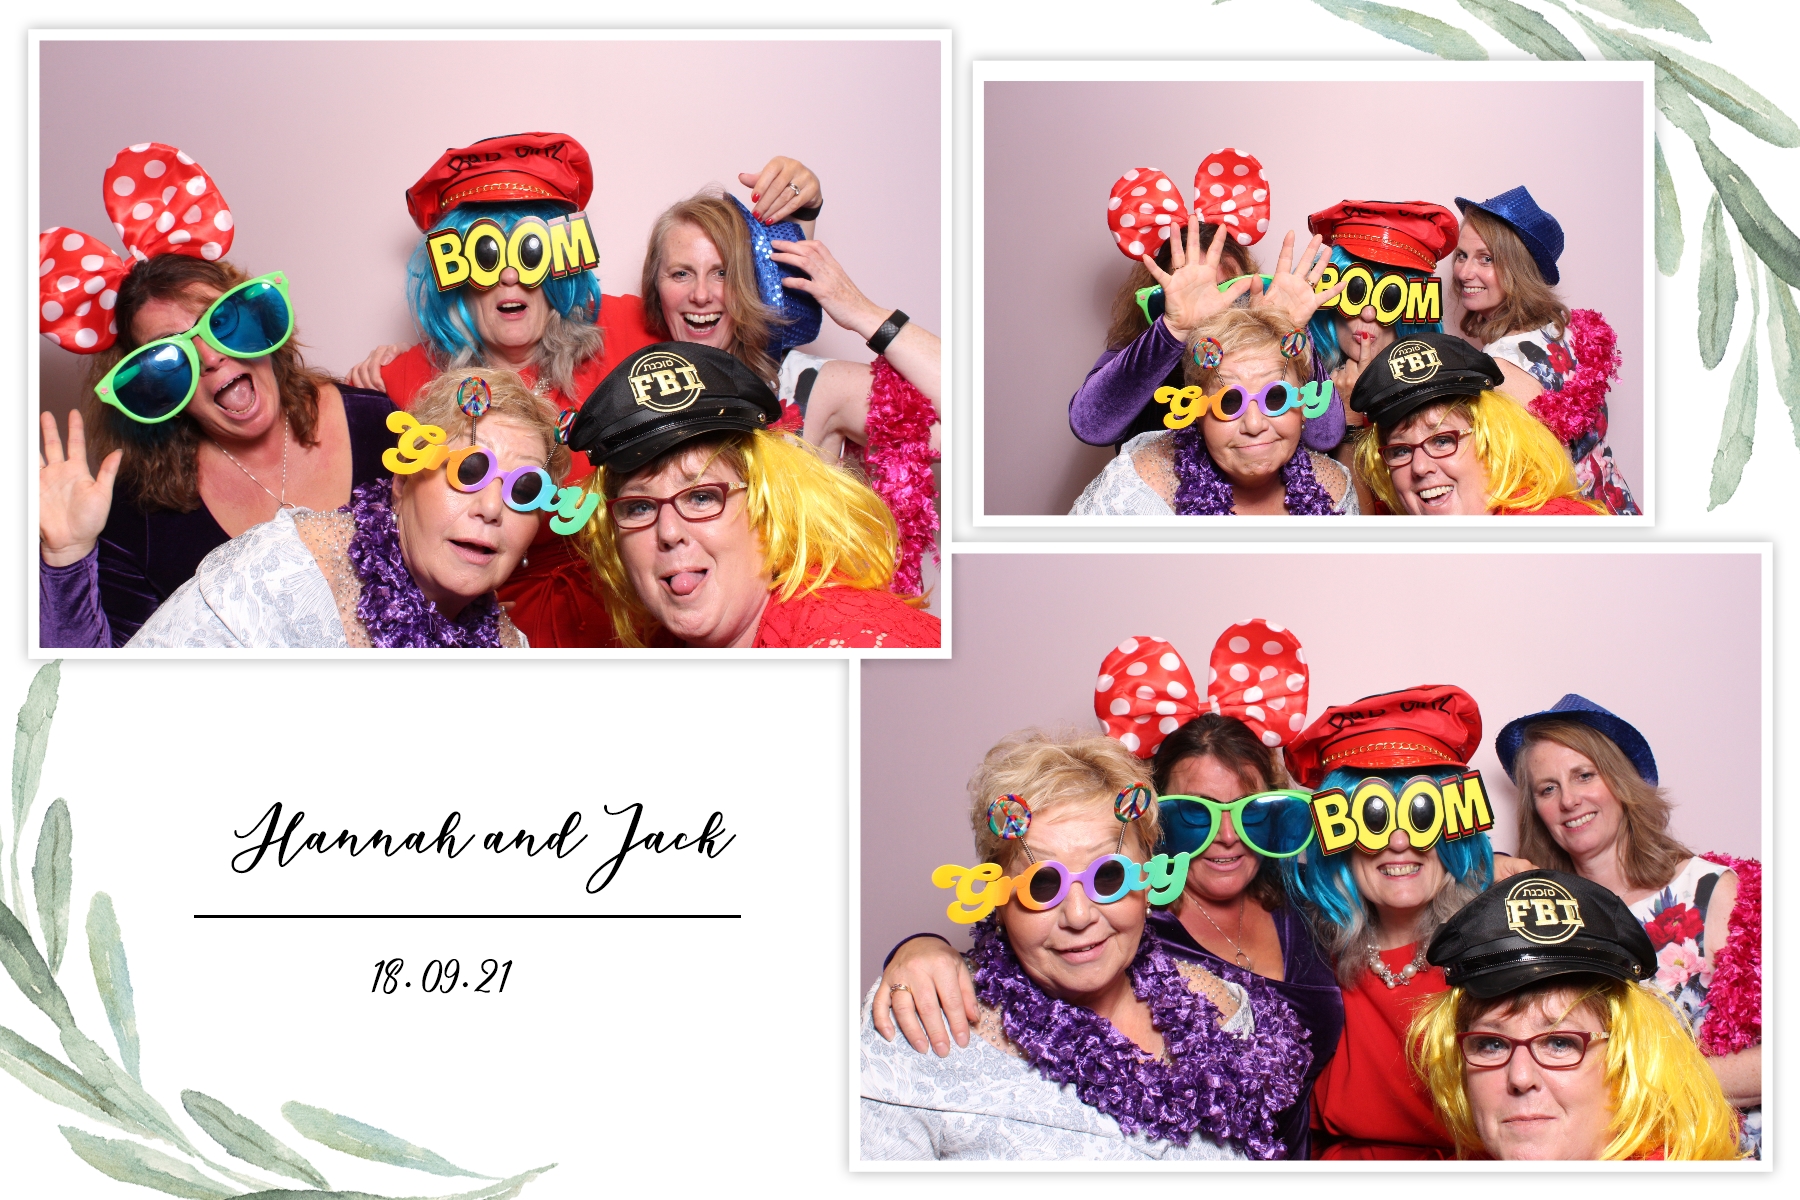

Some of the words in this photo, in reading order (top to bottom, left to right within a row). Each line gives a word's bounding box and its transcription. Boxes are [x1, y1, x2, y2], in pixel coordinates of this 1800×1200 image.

[426, 211, 600, 292] BOOM
[1389, 348, 1442, 378] FBI
[629, 364, 705, 404] FBI
[1310, 770, 1494, 857] BOOM
[1506, 898, 1583, 928] FBI
